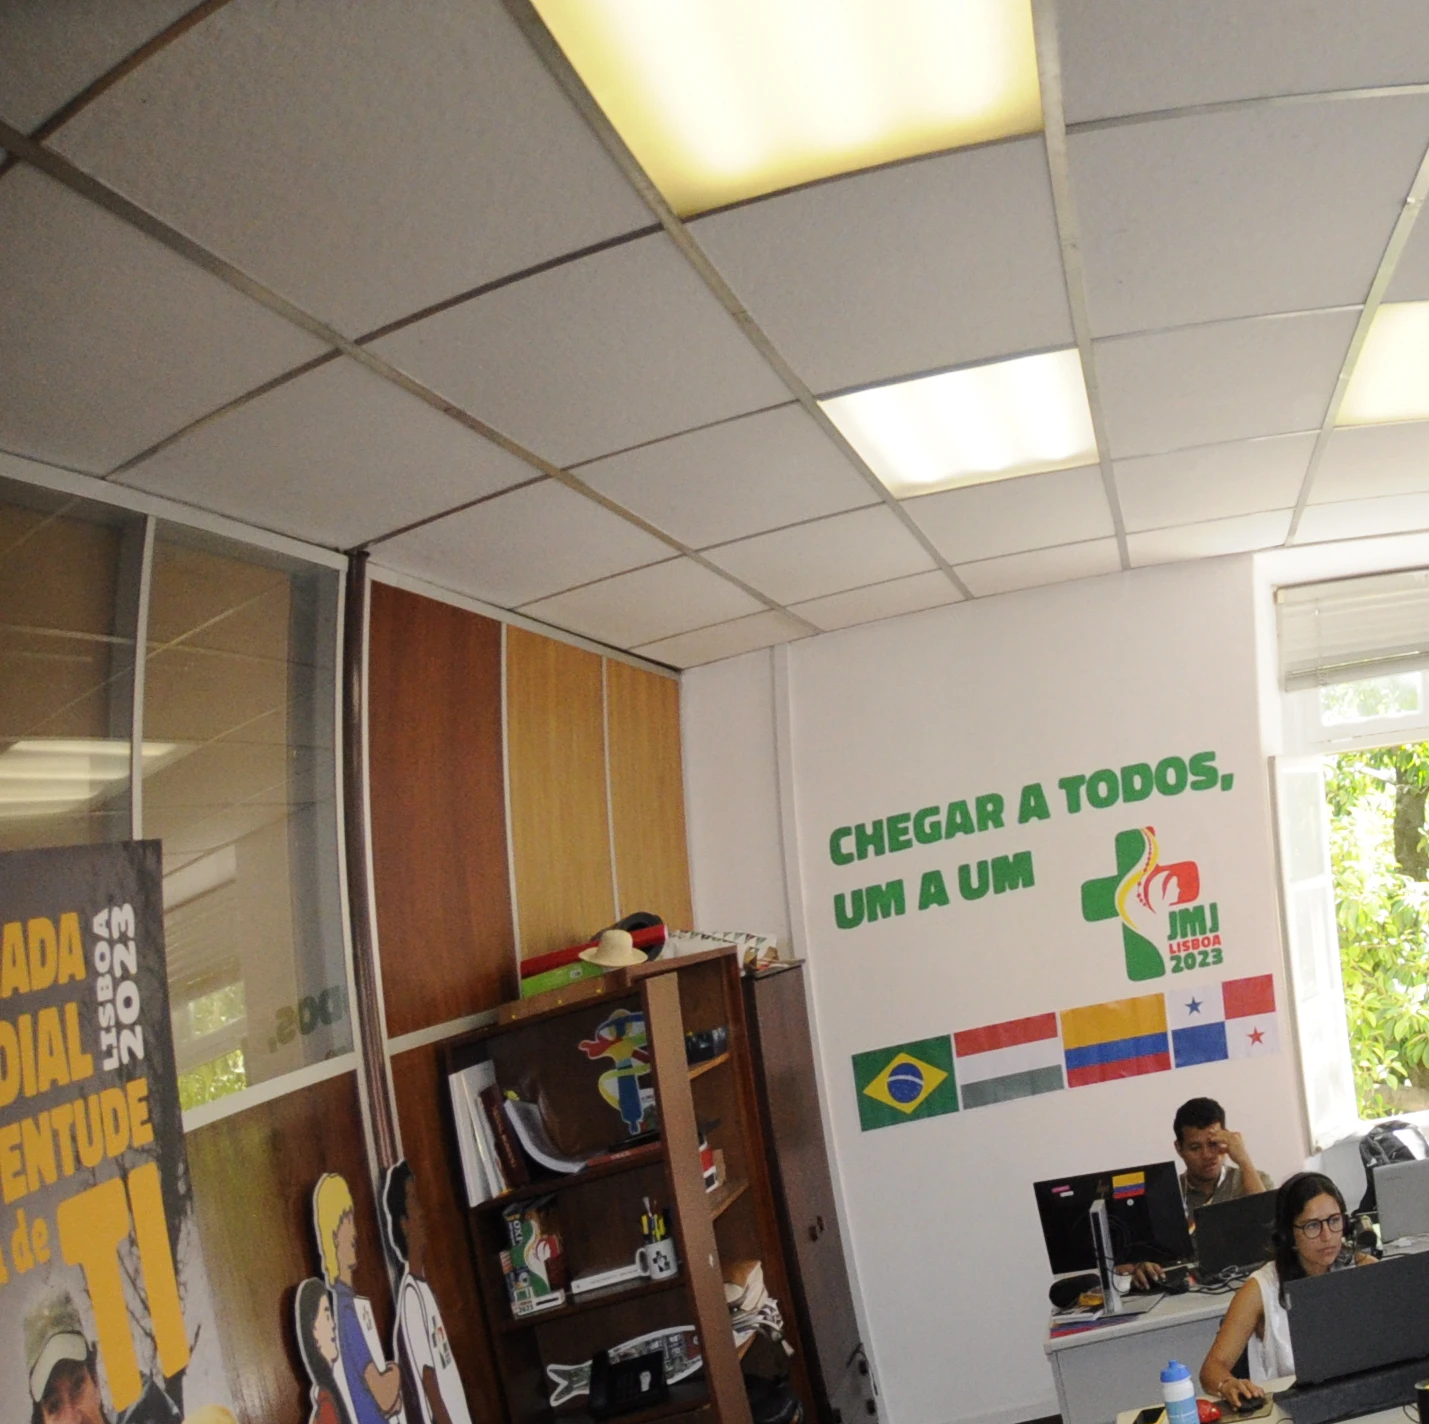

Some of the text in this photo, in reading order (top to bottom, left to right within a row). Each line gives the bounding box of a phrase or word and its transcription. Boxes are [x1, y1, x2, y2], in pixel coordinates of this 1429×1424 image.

[829, 750, 1235, 866] CHEGAR A TODOS,
[833, 850, 1035, 930] UM A UM
[1167, 902, 1219, 941] JMJ
[93, 908, 120, 1072] LISBOA
[110, 902, 144, 1066] 2023
[1168, 934, 1222, 955] LISBOA
[1170, 947, 1224, 974] 2023
[11, 1160, 191, 1413] de TI
